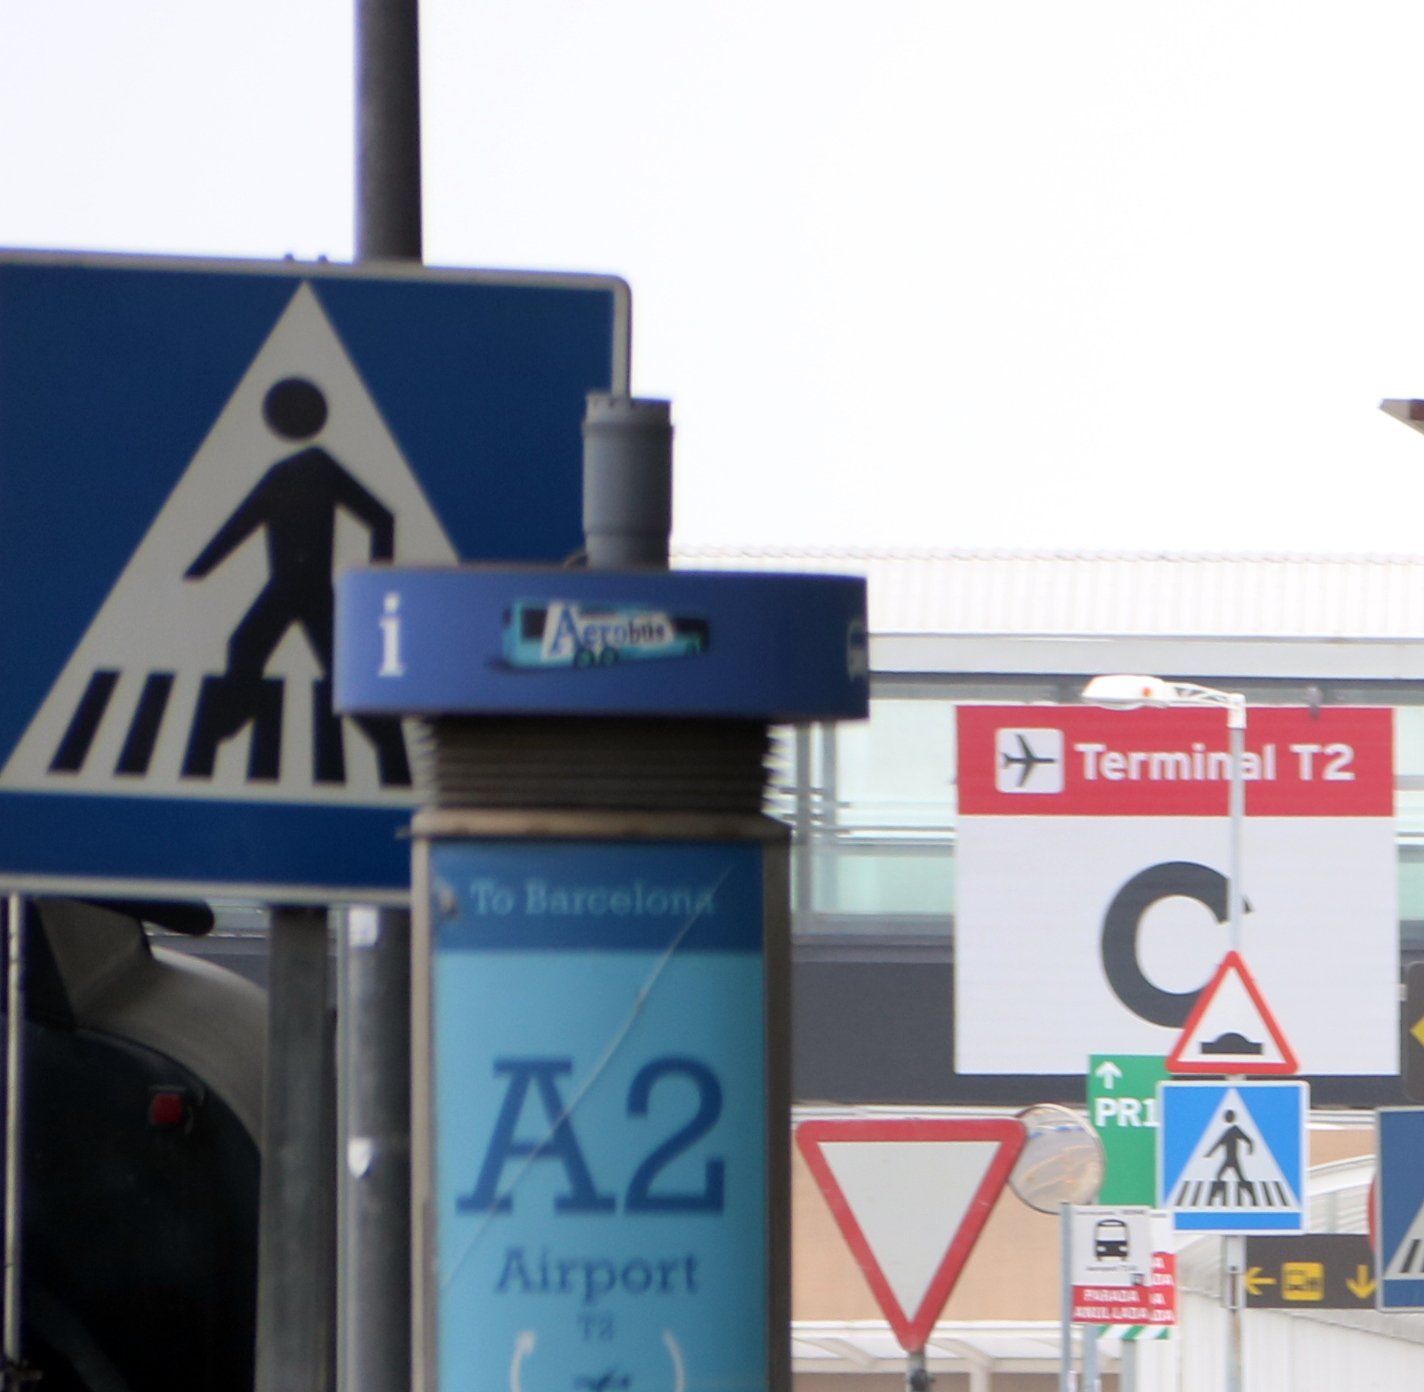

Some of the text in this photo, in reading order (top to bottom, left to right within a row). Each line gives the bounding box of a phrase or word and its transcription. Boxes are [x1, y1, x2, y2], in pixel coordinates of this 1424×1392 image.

[549, 604, 667, 655] Aerobus
[1075, 743, 1356, 782] Terminal T2
[470, 878, 716, 916] To Barcelona
[1101, 861, 1255, 1029] C
[455, 1053, 726, 1215] A2
[1095, 1098, 1159, 1128] PR1
[495, 1247, 699, 1305] Airport
[1082, 1288, 1140, 1303] PARADA
